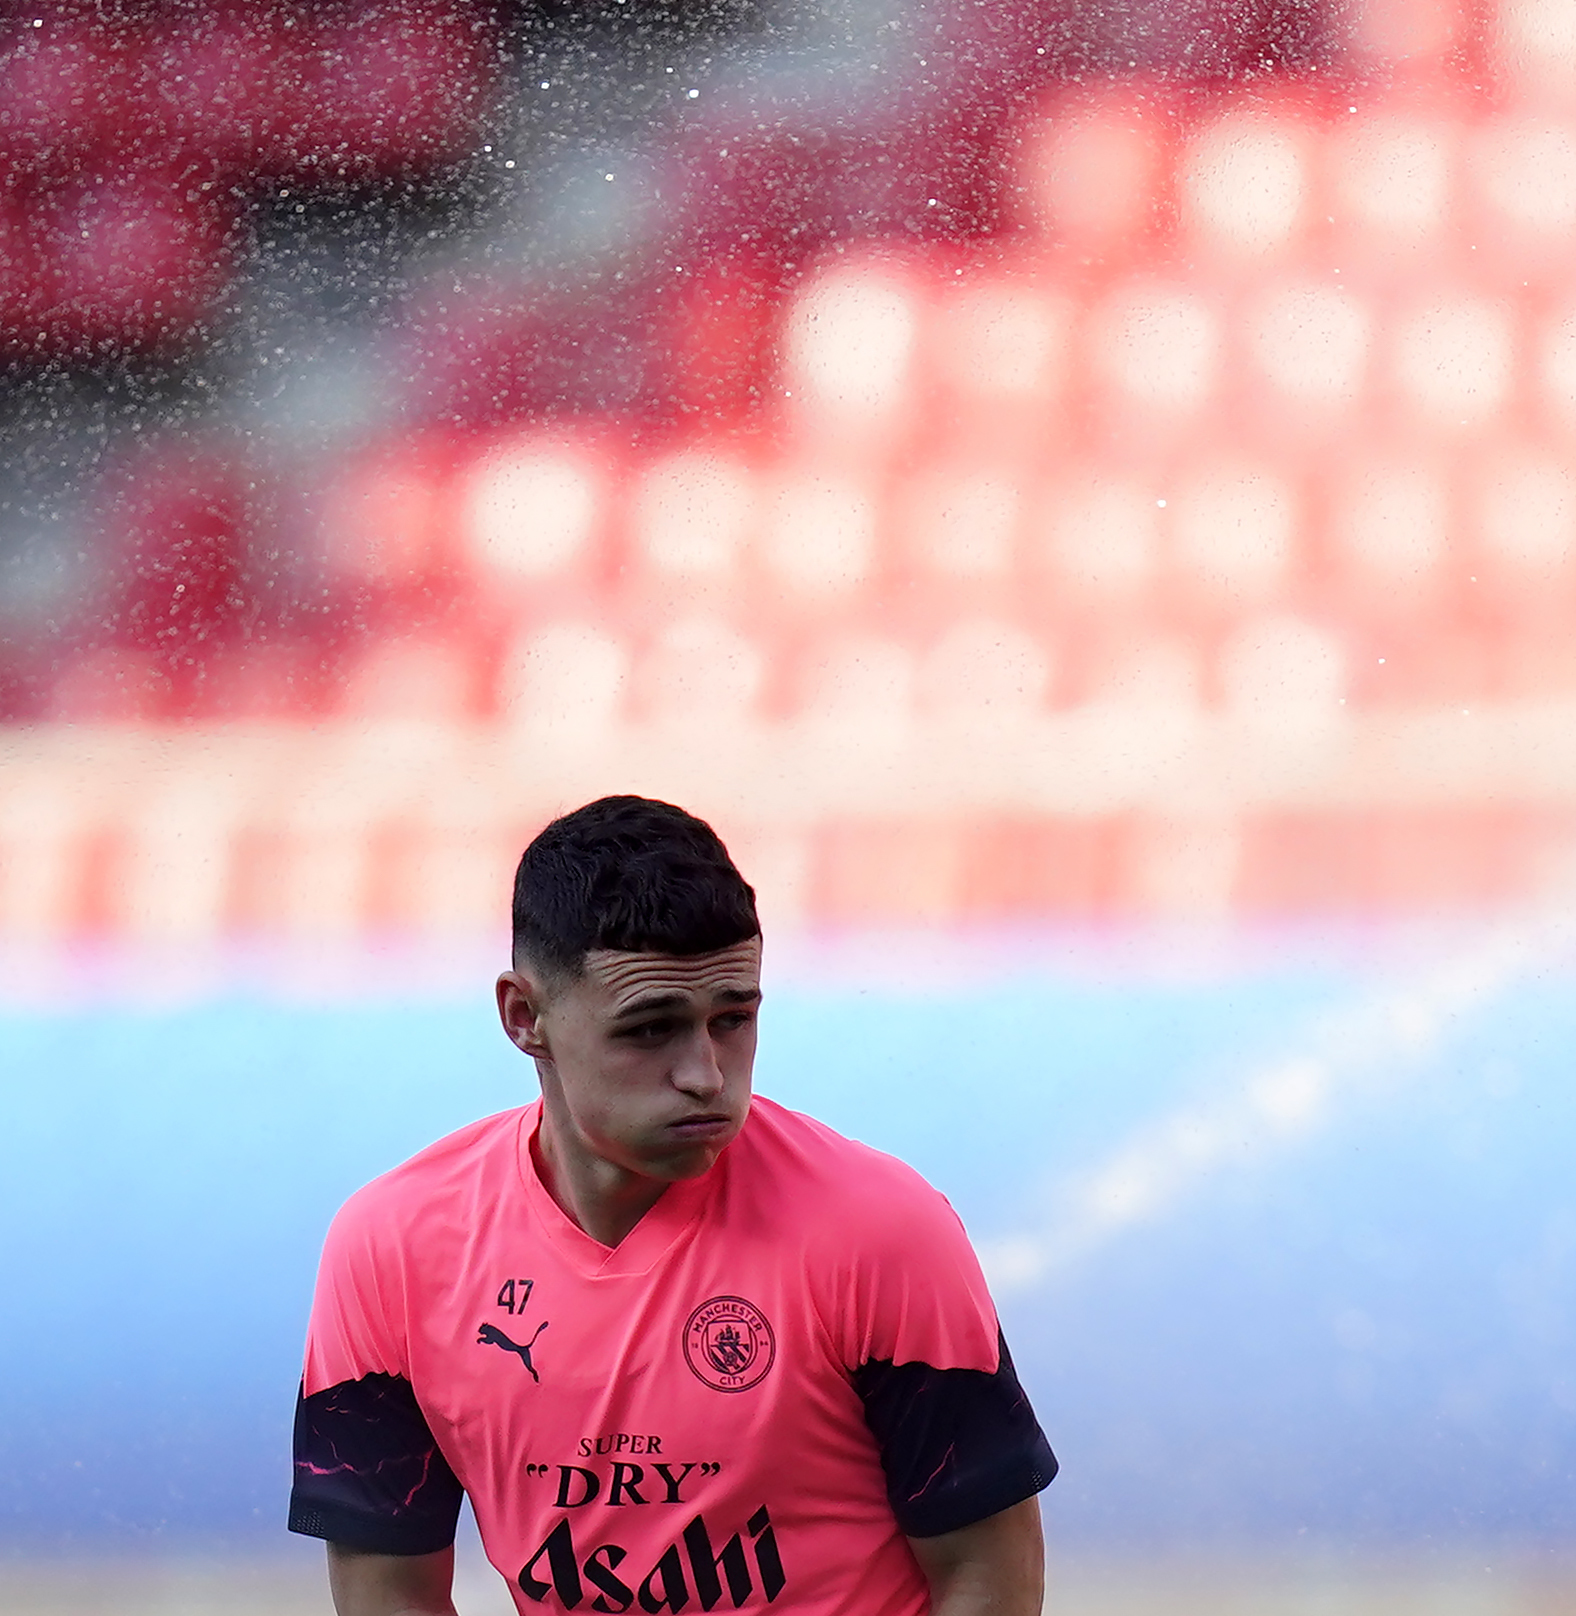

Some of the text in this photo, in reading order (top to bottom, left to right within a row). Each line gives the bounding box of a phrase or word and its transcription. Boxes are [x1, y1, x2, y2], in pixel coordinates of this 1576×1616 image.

[497, 1279, 535, 1315] 47
[693, 1303, 762, 1332] MANCHESTER
[719, 1376, 746, 1385] CITY
[577, 1433, 663, 1457] SUPER
[517, 1504, 787, 1616] Asahi
